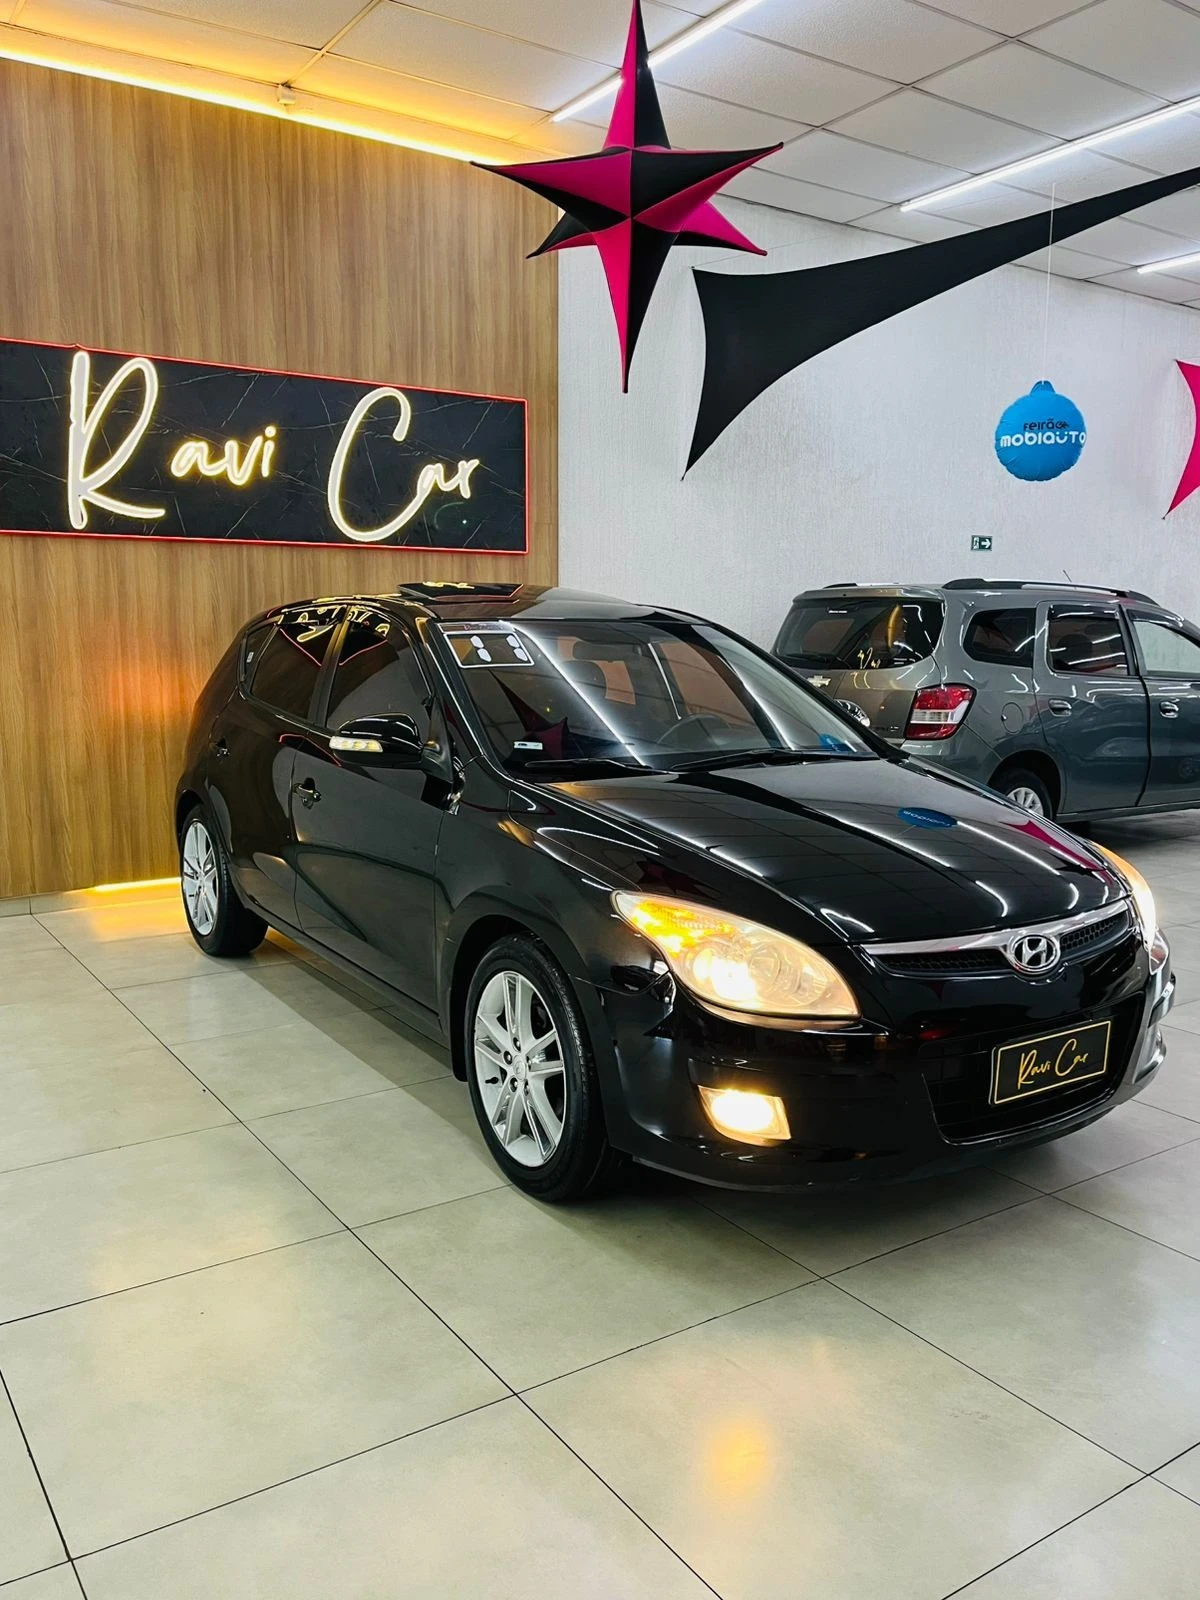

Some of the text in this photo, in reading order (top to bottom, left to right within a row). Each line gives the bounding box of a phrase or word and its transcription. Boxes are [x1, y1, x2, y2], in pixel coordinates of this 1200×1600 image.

[67, 350, 480, 543] Ravi Car
[1017, 1038, 1089, 1090] Ravi Car
